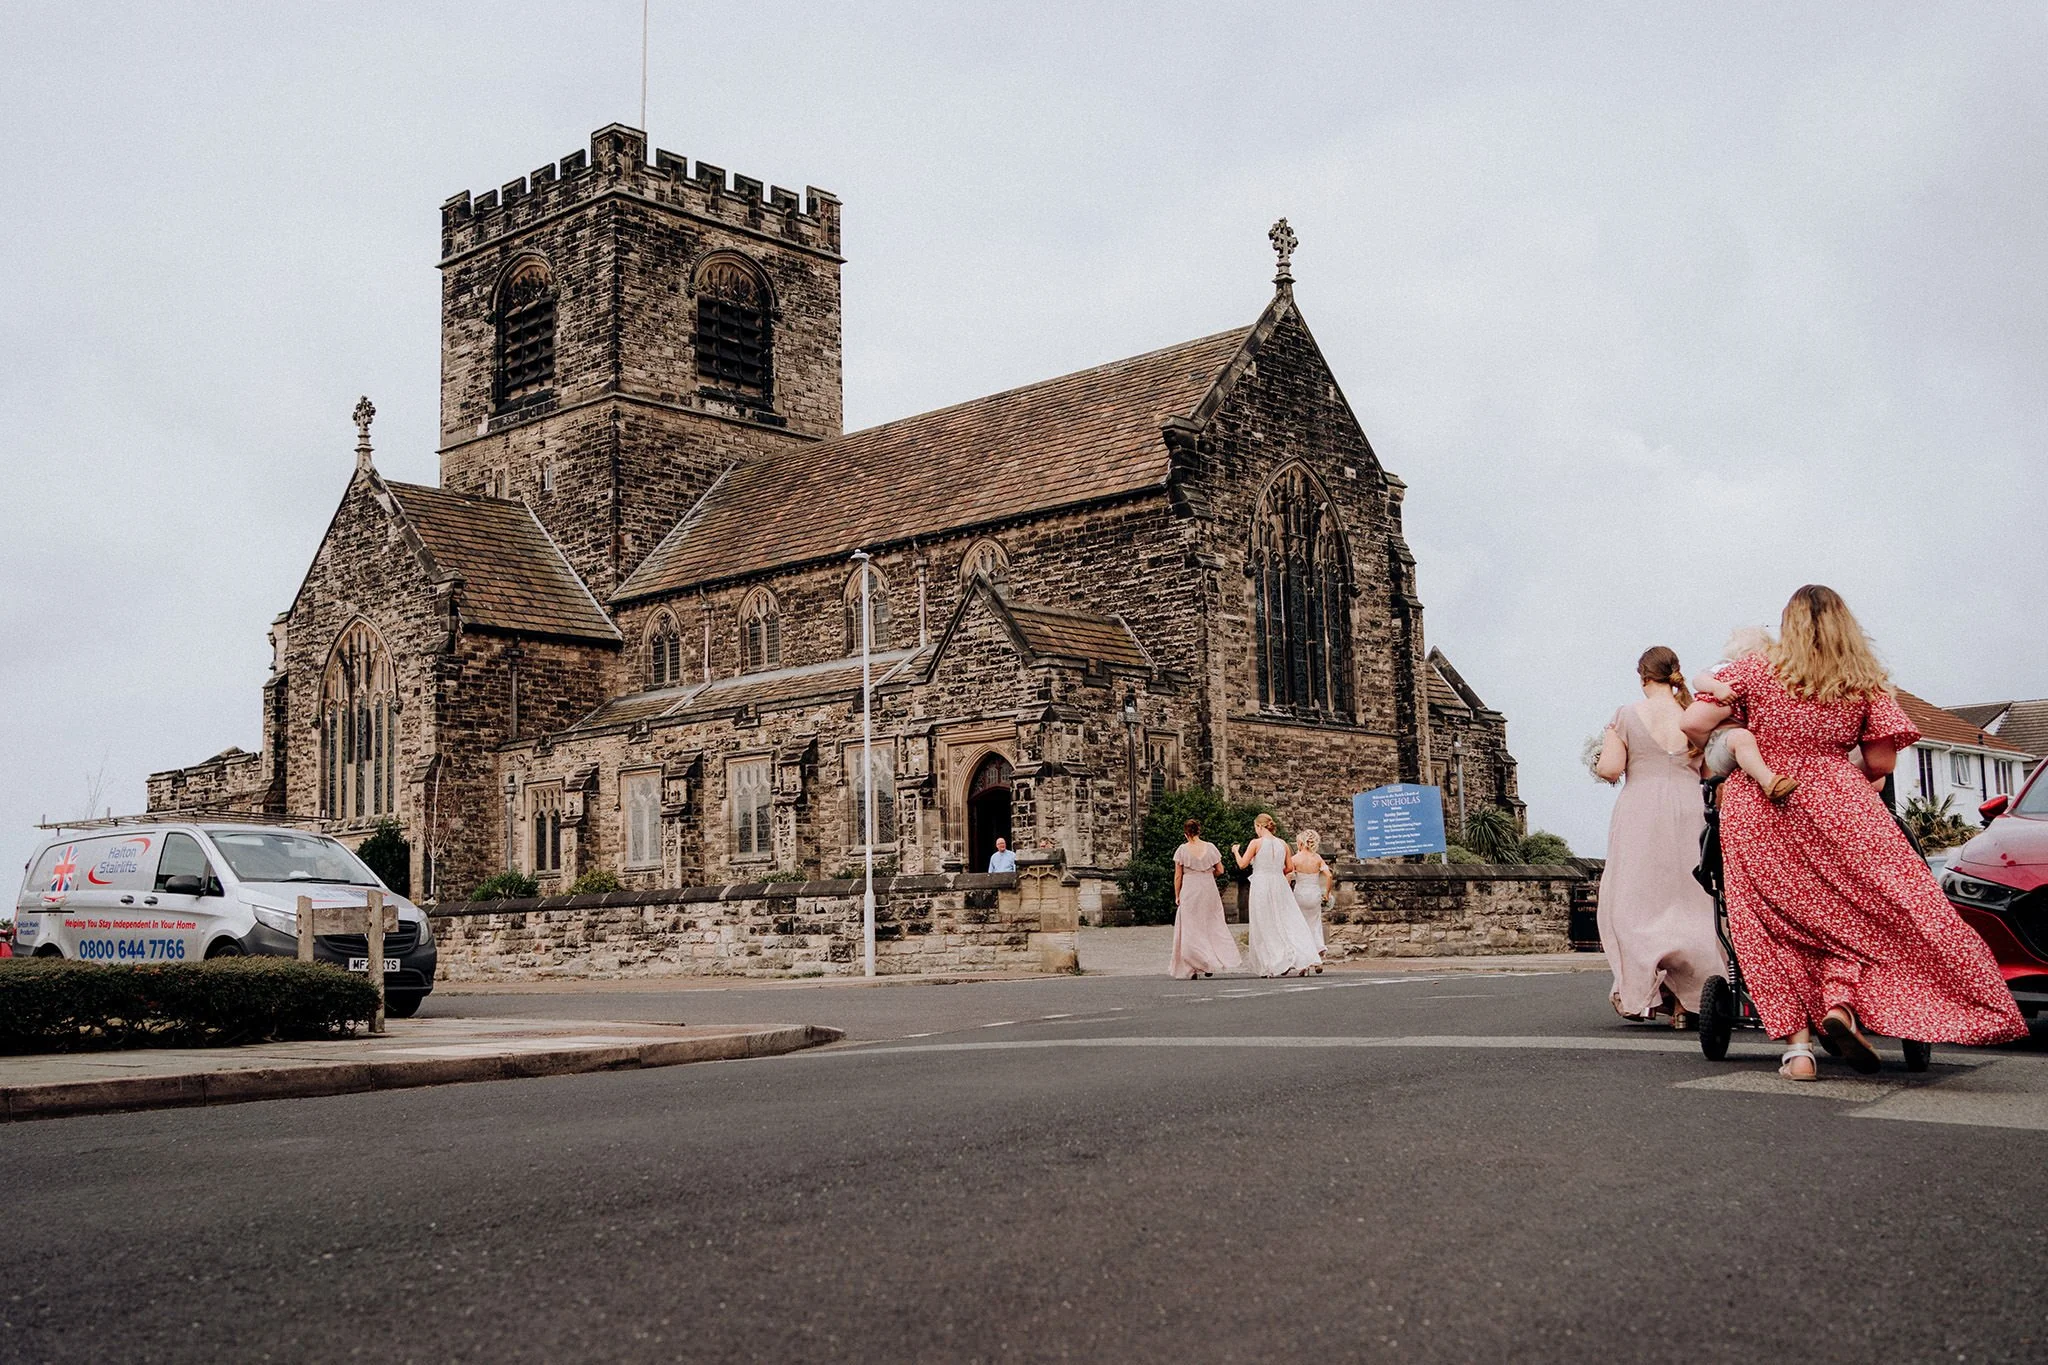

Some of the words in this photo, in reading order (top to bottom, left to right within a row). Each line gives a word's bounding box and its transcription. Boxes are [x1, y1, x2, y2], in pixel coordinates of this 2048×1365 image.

[1381, 795, 1421, 807] NICHOLAS
[108, 847, 137, 859] Halton
[99, 861, 137, 874] Stairlifts
[65, 919, 86, 930] Helping
[87, 919, 97, 928] You
[98, 919, 112, 930] Stay
[113, 919, 151, 930] Independent
[152, 920, 159, 929] In
[161, 919, 175, 929] Your
[176, 919, 196, 930] Home
[80, 939, 115, 959] 0800
[118, 939, 146, 959] 644
[149, 939, 185, 959] 7766
